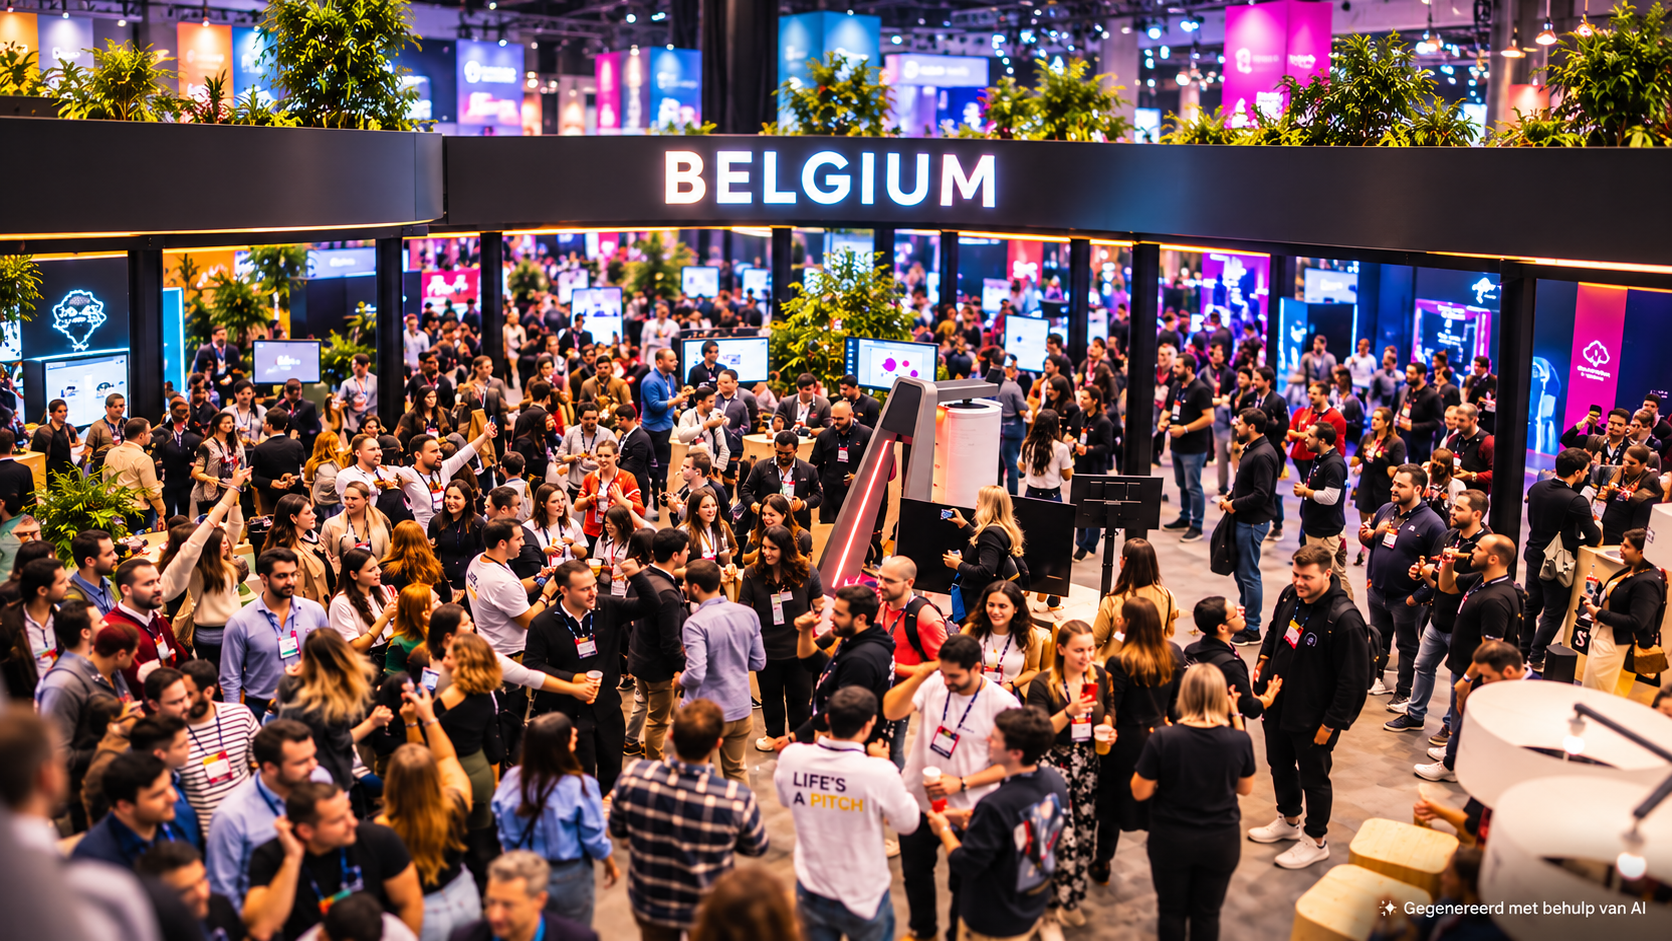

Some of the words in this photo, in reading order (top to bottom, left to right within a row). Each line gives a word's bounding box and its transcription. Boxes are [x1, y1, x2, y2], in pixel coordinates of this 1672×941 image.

[664, 150, 997, 208] BELGIUM
[793, 771, 846, 792] LIFE'S
[793, 792, 805, 806] A
[810, 793, 863, 812] PITCH
